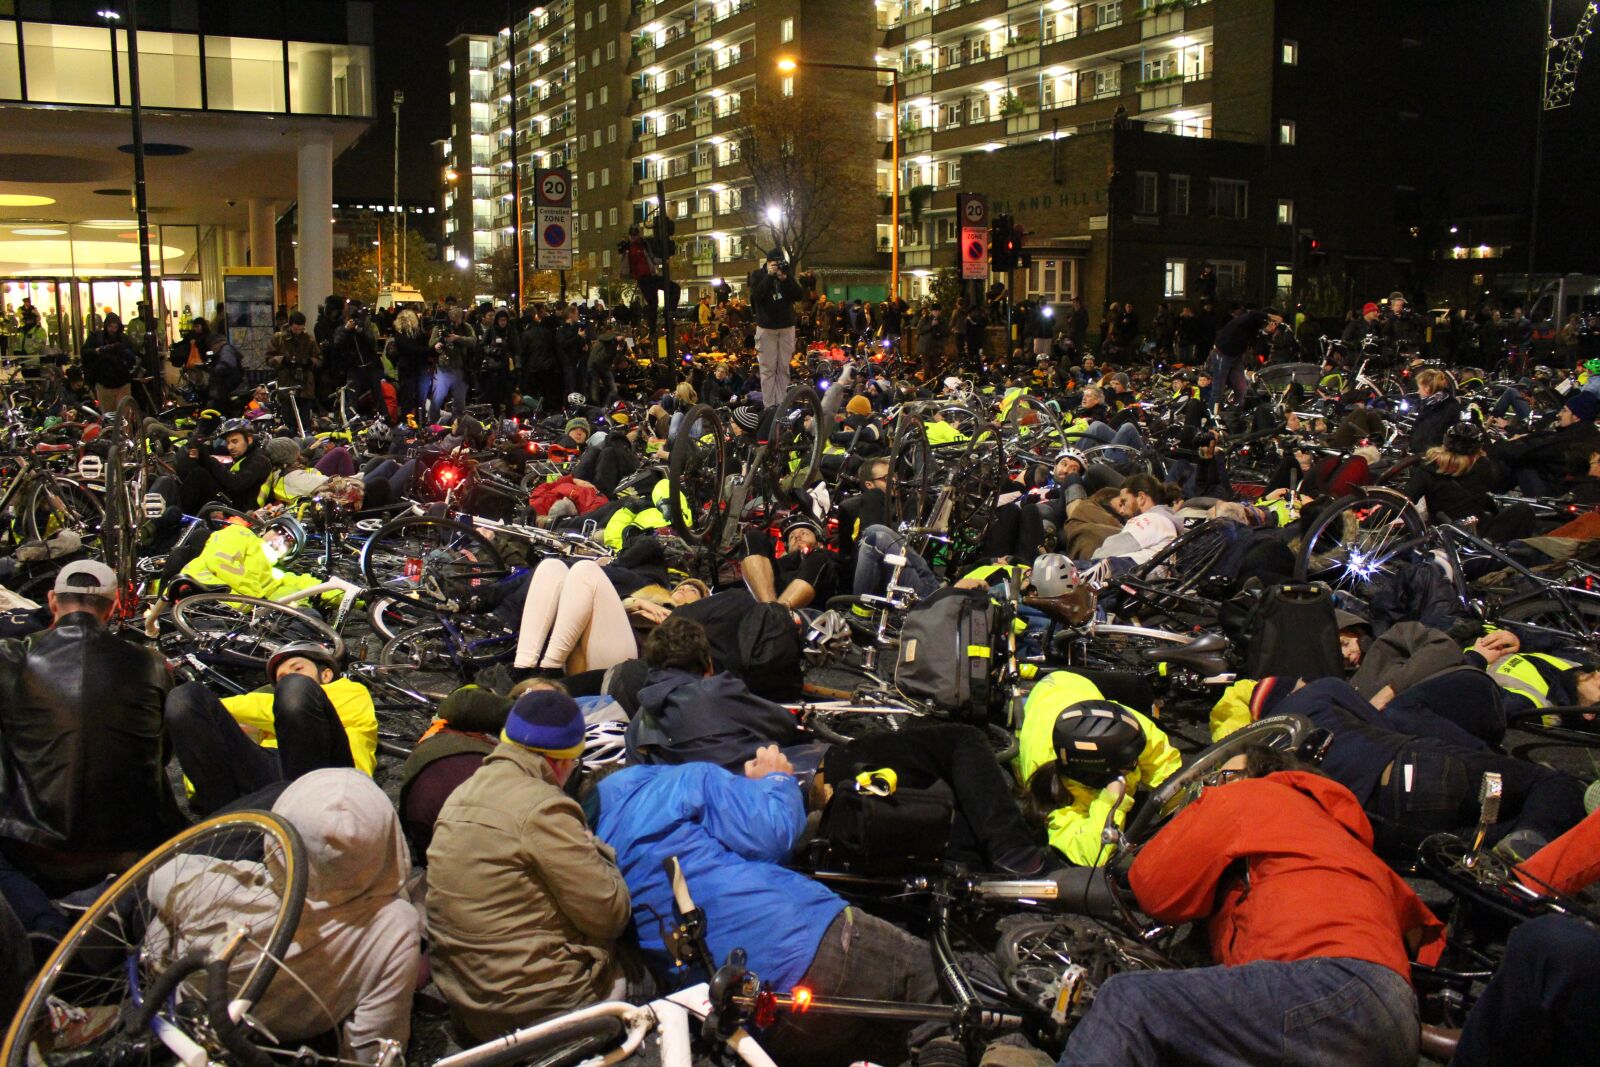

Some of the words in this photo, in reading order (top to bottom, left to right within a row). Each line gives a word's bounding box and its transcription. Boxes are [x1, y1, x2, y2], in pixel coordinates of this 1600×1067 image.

[544, 182, 564, 194] 20
[1060, 190, 1102, 207] HILL
[967, 205, 983, 217] 20
